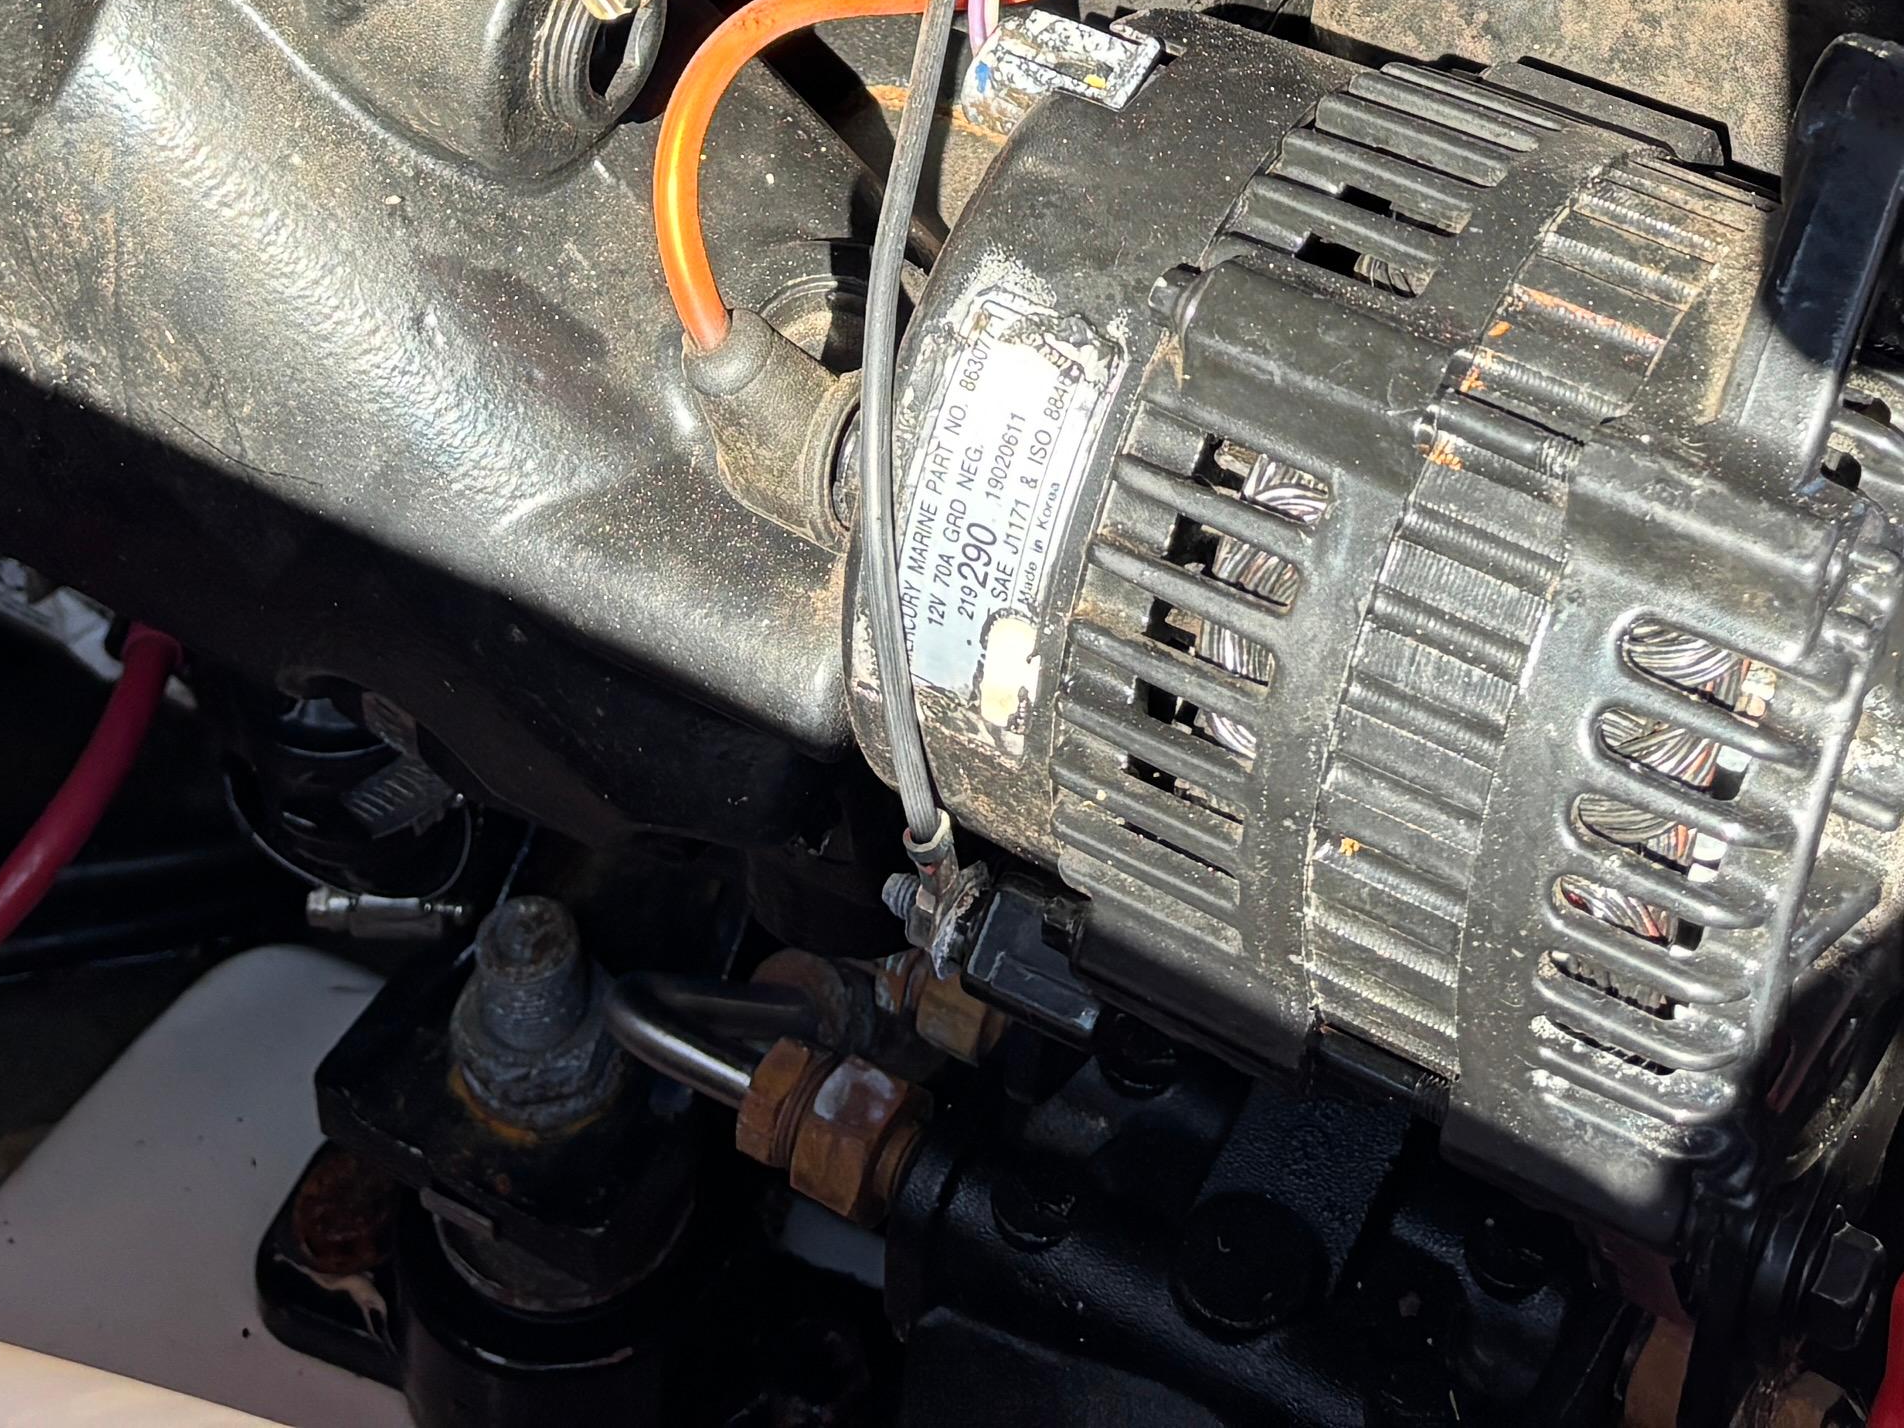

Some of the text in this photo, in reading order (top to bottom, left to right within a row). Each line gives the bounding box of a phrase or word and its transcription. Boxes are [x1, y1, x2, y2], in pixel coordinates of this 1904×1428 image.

[906, 499, 938, 574] MARINE
[924, 440, 955, 494] PART
[945, 400, 969, 435] NO.
[1020, 474, 1038, 489] &
[1027, 428, 1052, 465] ISO
[925, 439, 984, 625] 12V 70A GRD NEG.
[955, 410, 1024, 619] 219 290 19020611
[1002, 498, 1030, 553] J1171
[1016, 480, 1061, 605] Made in Korea
[989, 561, 1014, 601] SAE
